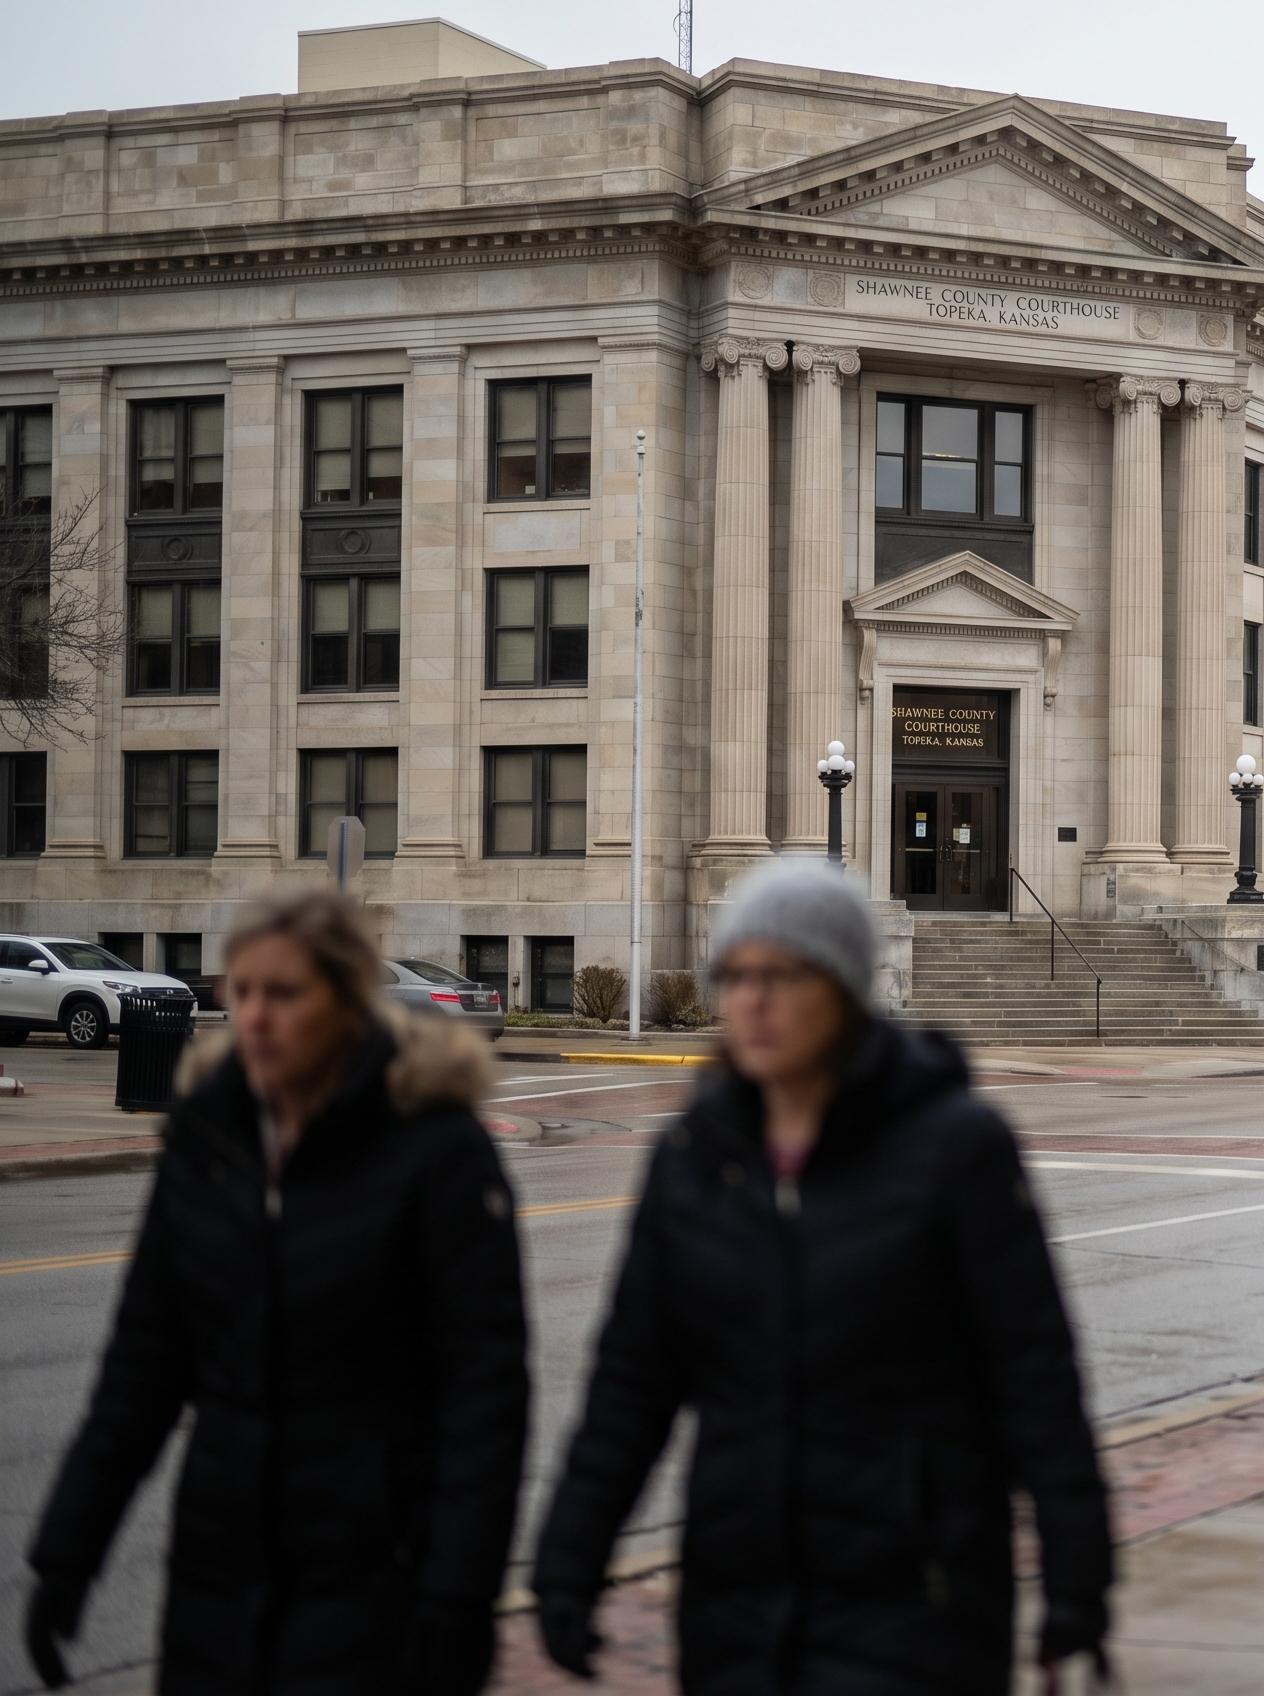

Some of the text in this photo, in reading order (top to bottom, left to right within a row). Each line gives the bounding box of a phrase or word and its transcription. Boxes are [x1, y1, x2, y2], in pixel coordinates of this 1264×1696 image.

[856, 279, 1120, 320] SHAWNEE COUNTY COURTHOUSE
[999, 310, 1059, 330] KANSAS
[890, 707, 996, 720] SHAWNEE COUNTY
[904, 721, 981, 734] COURTHOUSE
[946, 737, 984, 747] KANSAS
